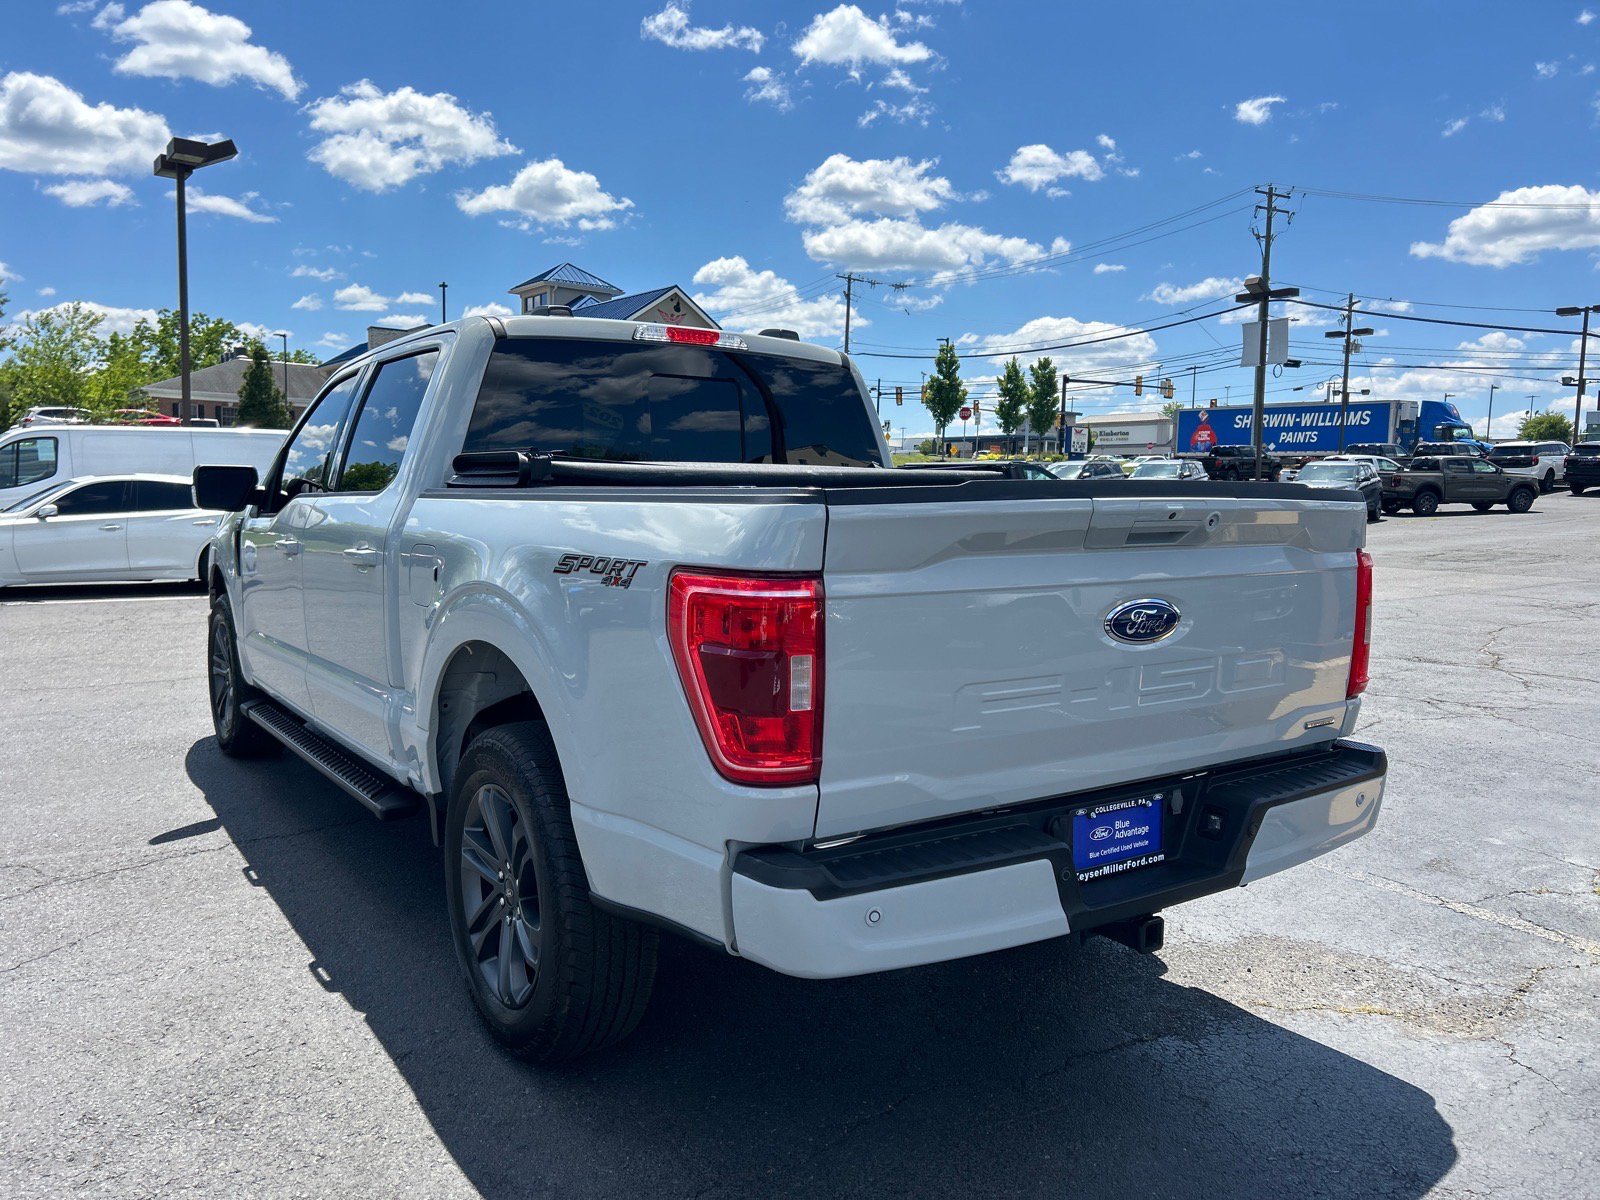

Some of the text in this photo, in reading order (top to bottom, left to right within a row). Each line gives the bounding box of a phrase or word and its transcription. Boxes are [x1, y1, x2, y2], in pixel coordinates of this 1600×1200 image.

[1233, 410, 1371, 428] SHRWIN-WILLIAMS
[1279, 431, 1318, 443] PAINTS
[553, 553, 649, 578] SPORT
[1126, 609, 1168, 635] Ford
[951, 648, 1288, 732] F-150
[1093, 828, 1110, 839] Ford
[1115, 820, 1130, 829] Blue
[1115, 825, 1150, 839] Advantage
[1089, 839, 1149, 859] Blue Certified Used Vehicle
